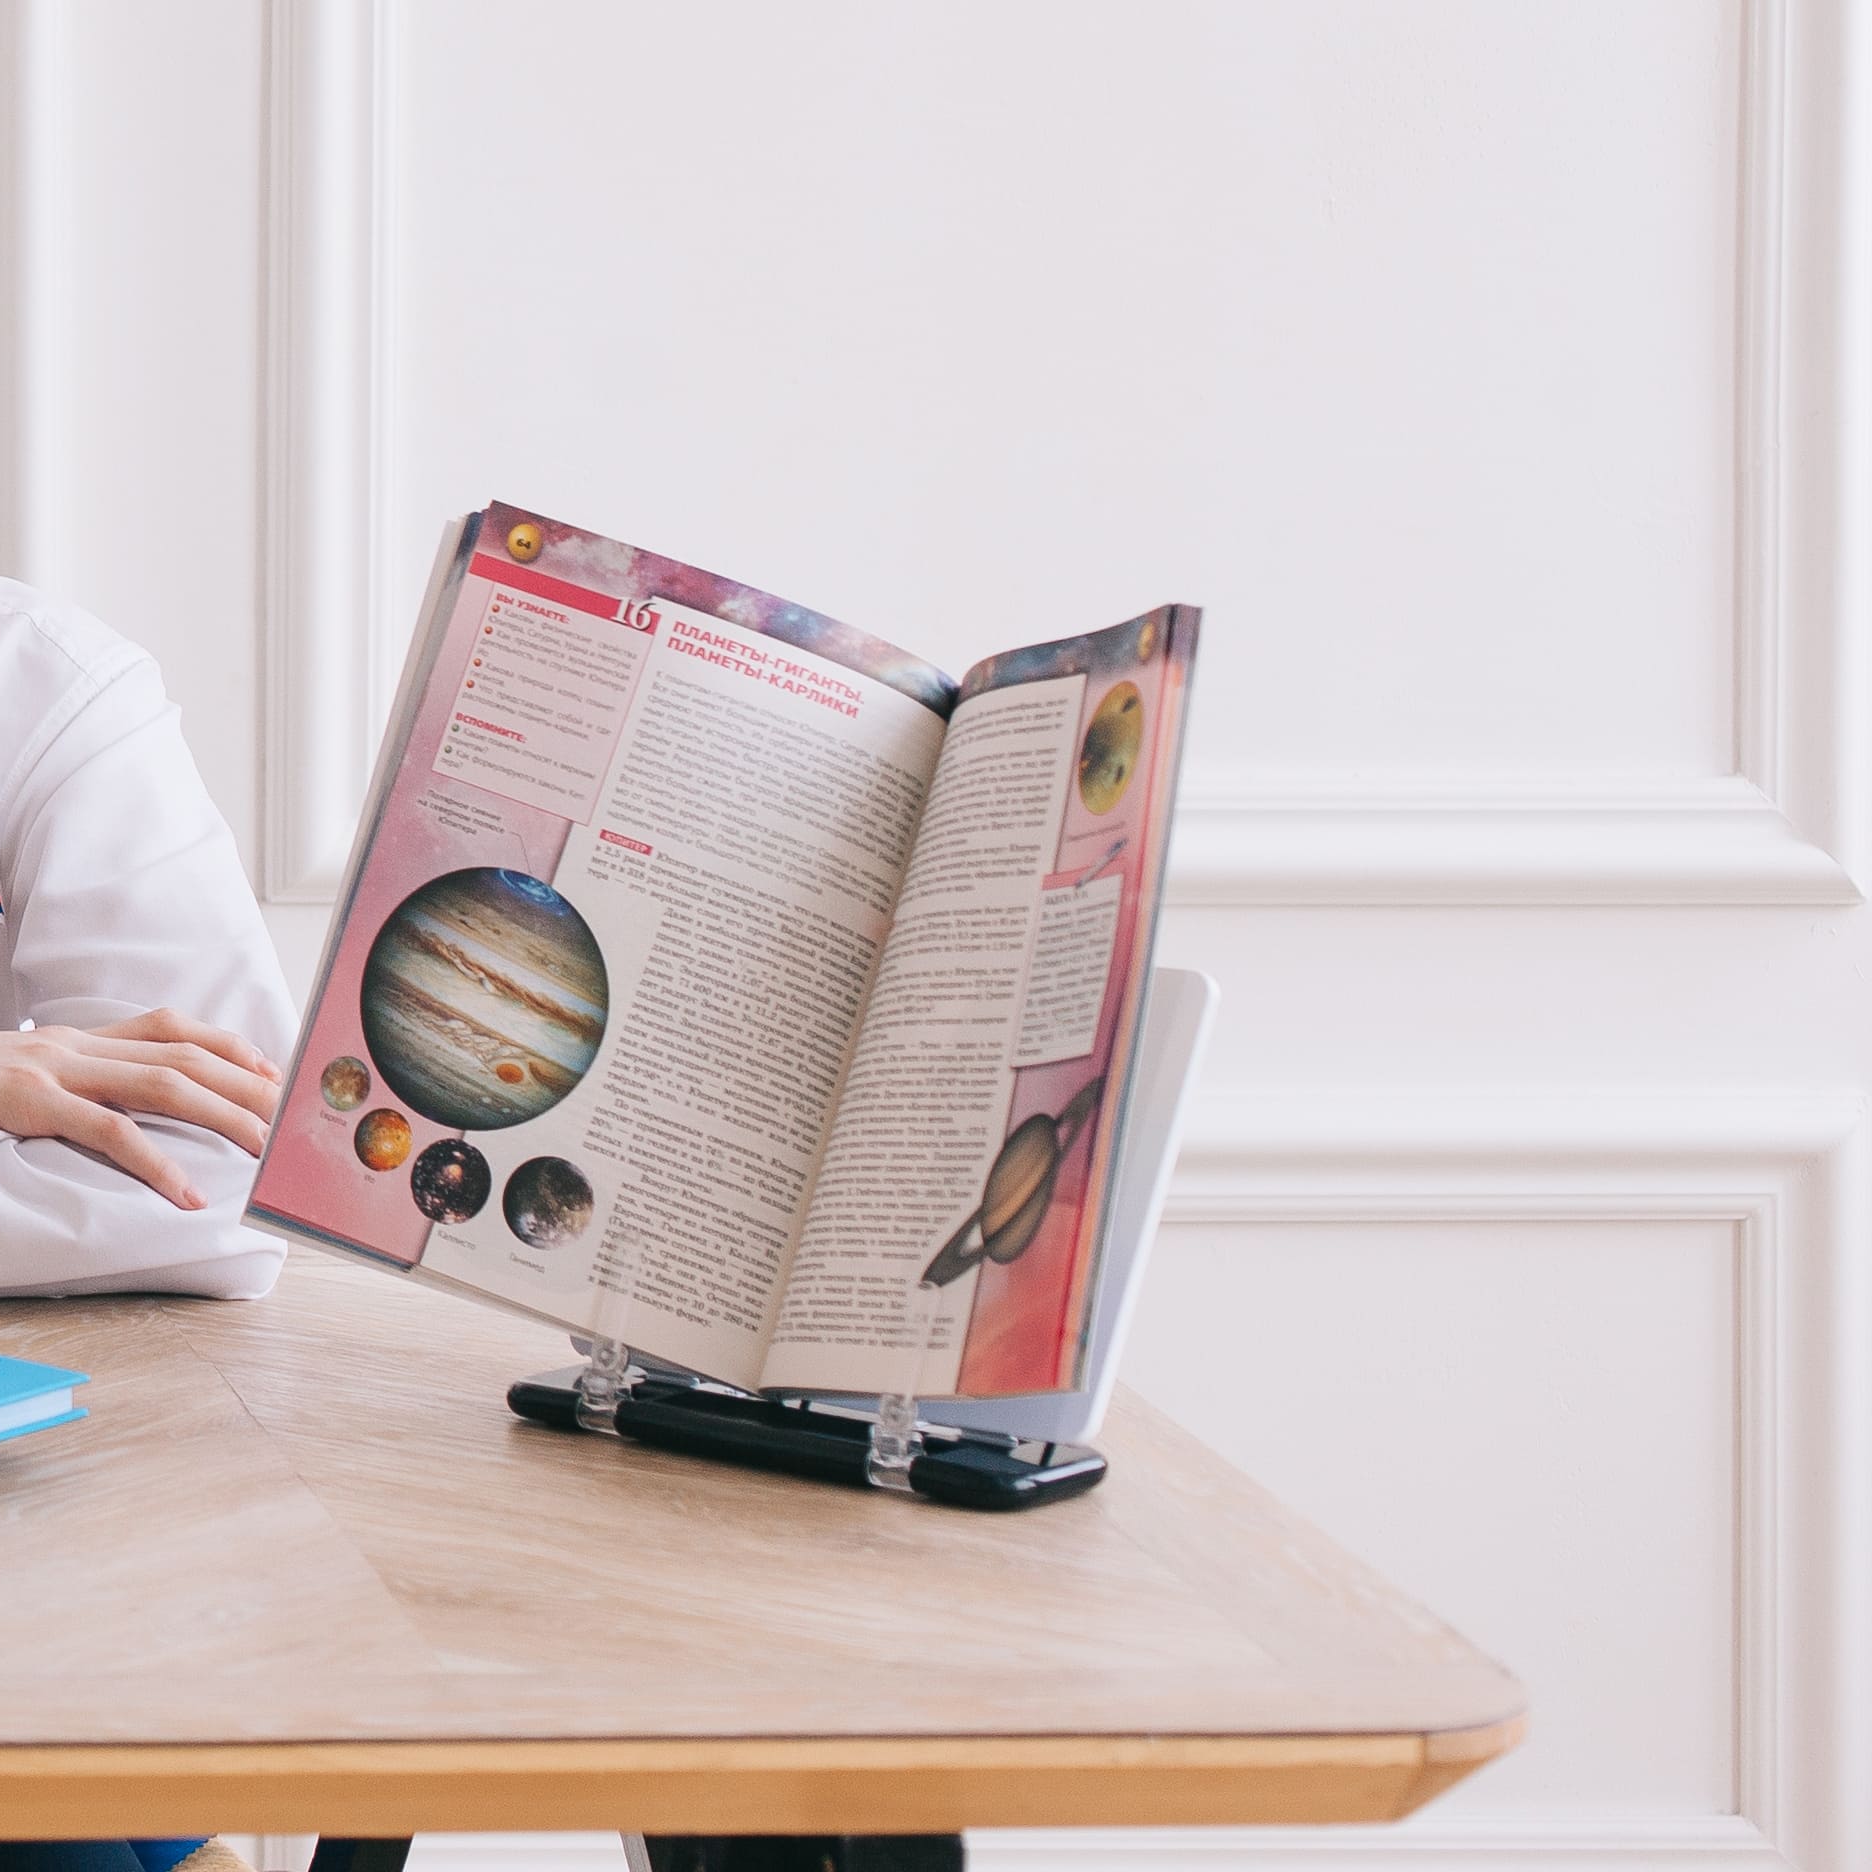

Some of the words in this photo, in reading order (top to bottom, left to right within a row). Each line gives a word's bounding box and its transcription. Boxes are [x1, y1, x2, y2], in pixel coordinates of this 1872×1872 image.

[516, 538, 531, 549] 64
[611, 595, 656, 631] 16
[665, 635, 860, 719] ПЛАНЕТЫ-КАРЛИКИ
[672, 620, 865, 705] ПЛАНЕТЫ-ГИГАНТЫ.
